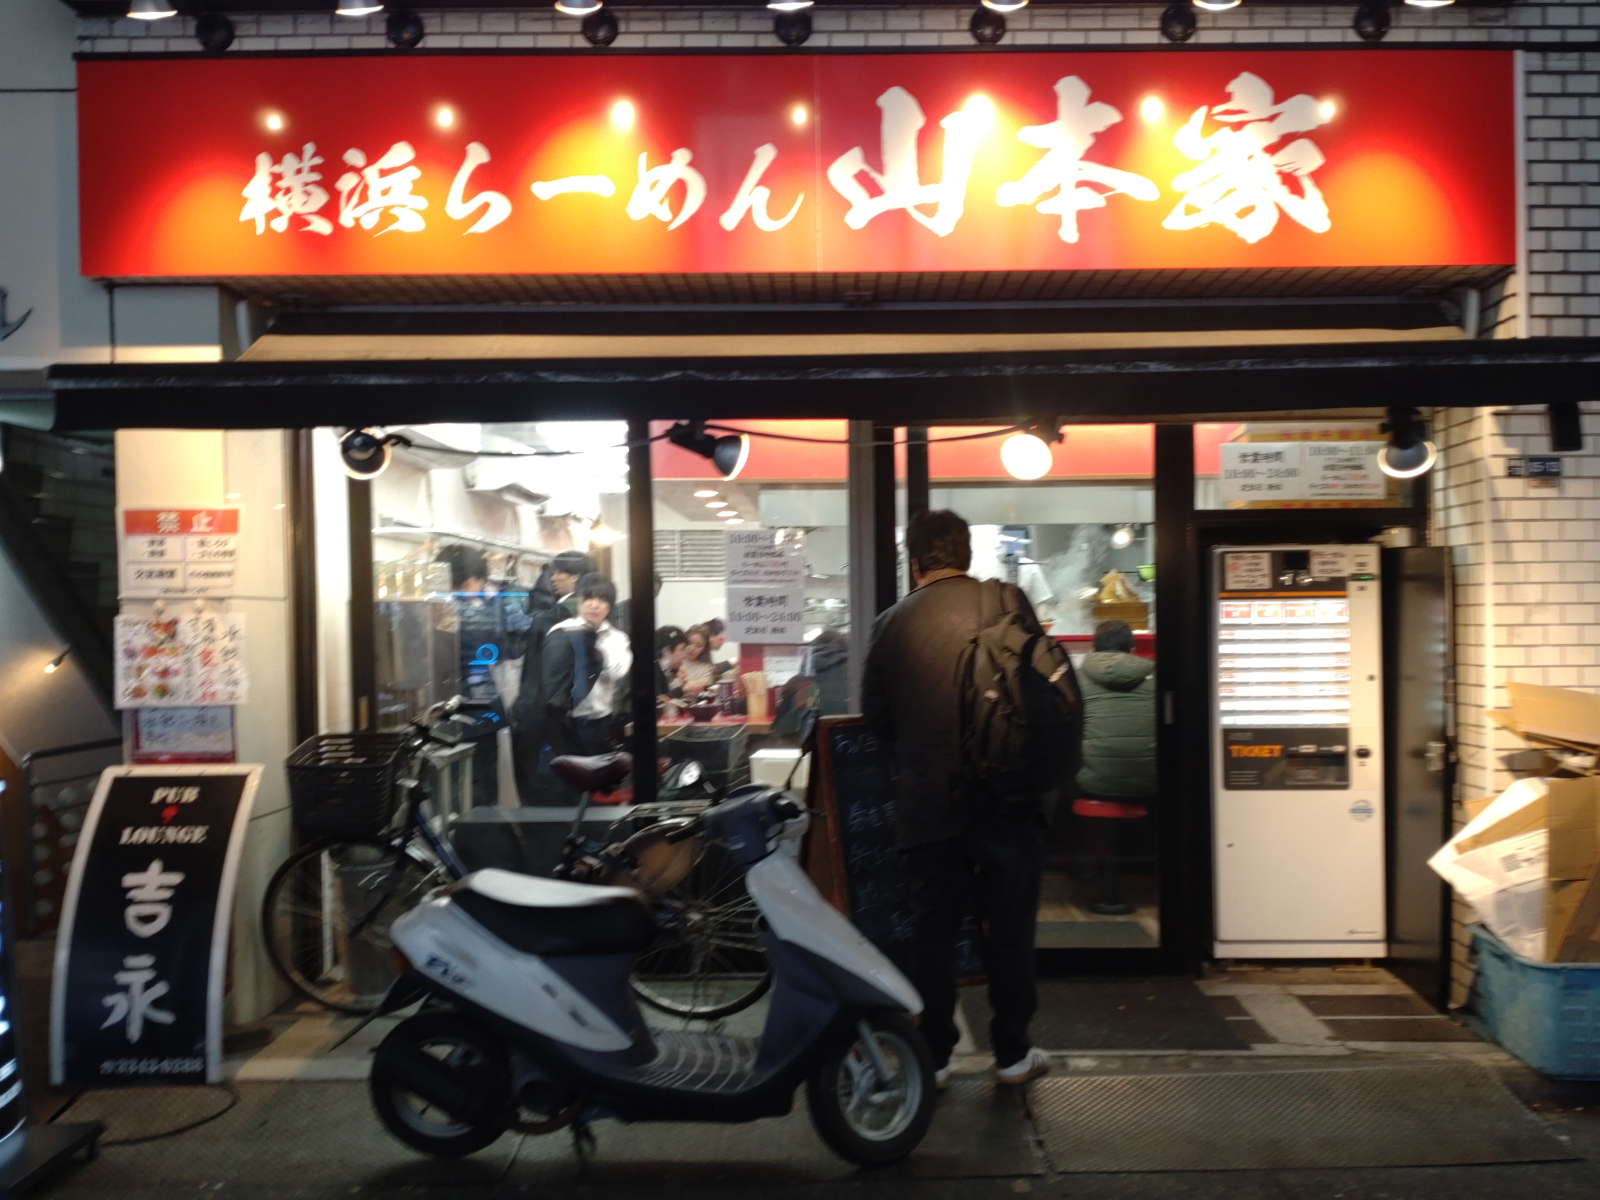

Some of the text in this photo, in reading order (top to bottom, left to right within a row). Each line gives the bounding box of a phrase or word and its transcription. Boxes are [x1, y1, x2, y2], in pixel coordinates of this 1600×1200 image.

[239, 71, 1332, 243] 横浜らーめん 山本家
[156, 511, 214, 533] 禁止
[1228, 744, 1284, 758] TICKET
[150, 786, 201, 804] PUB
[118, 825, 209, 845] LOUNGE
[100, 858, 186, 1044] 吉永
